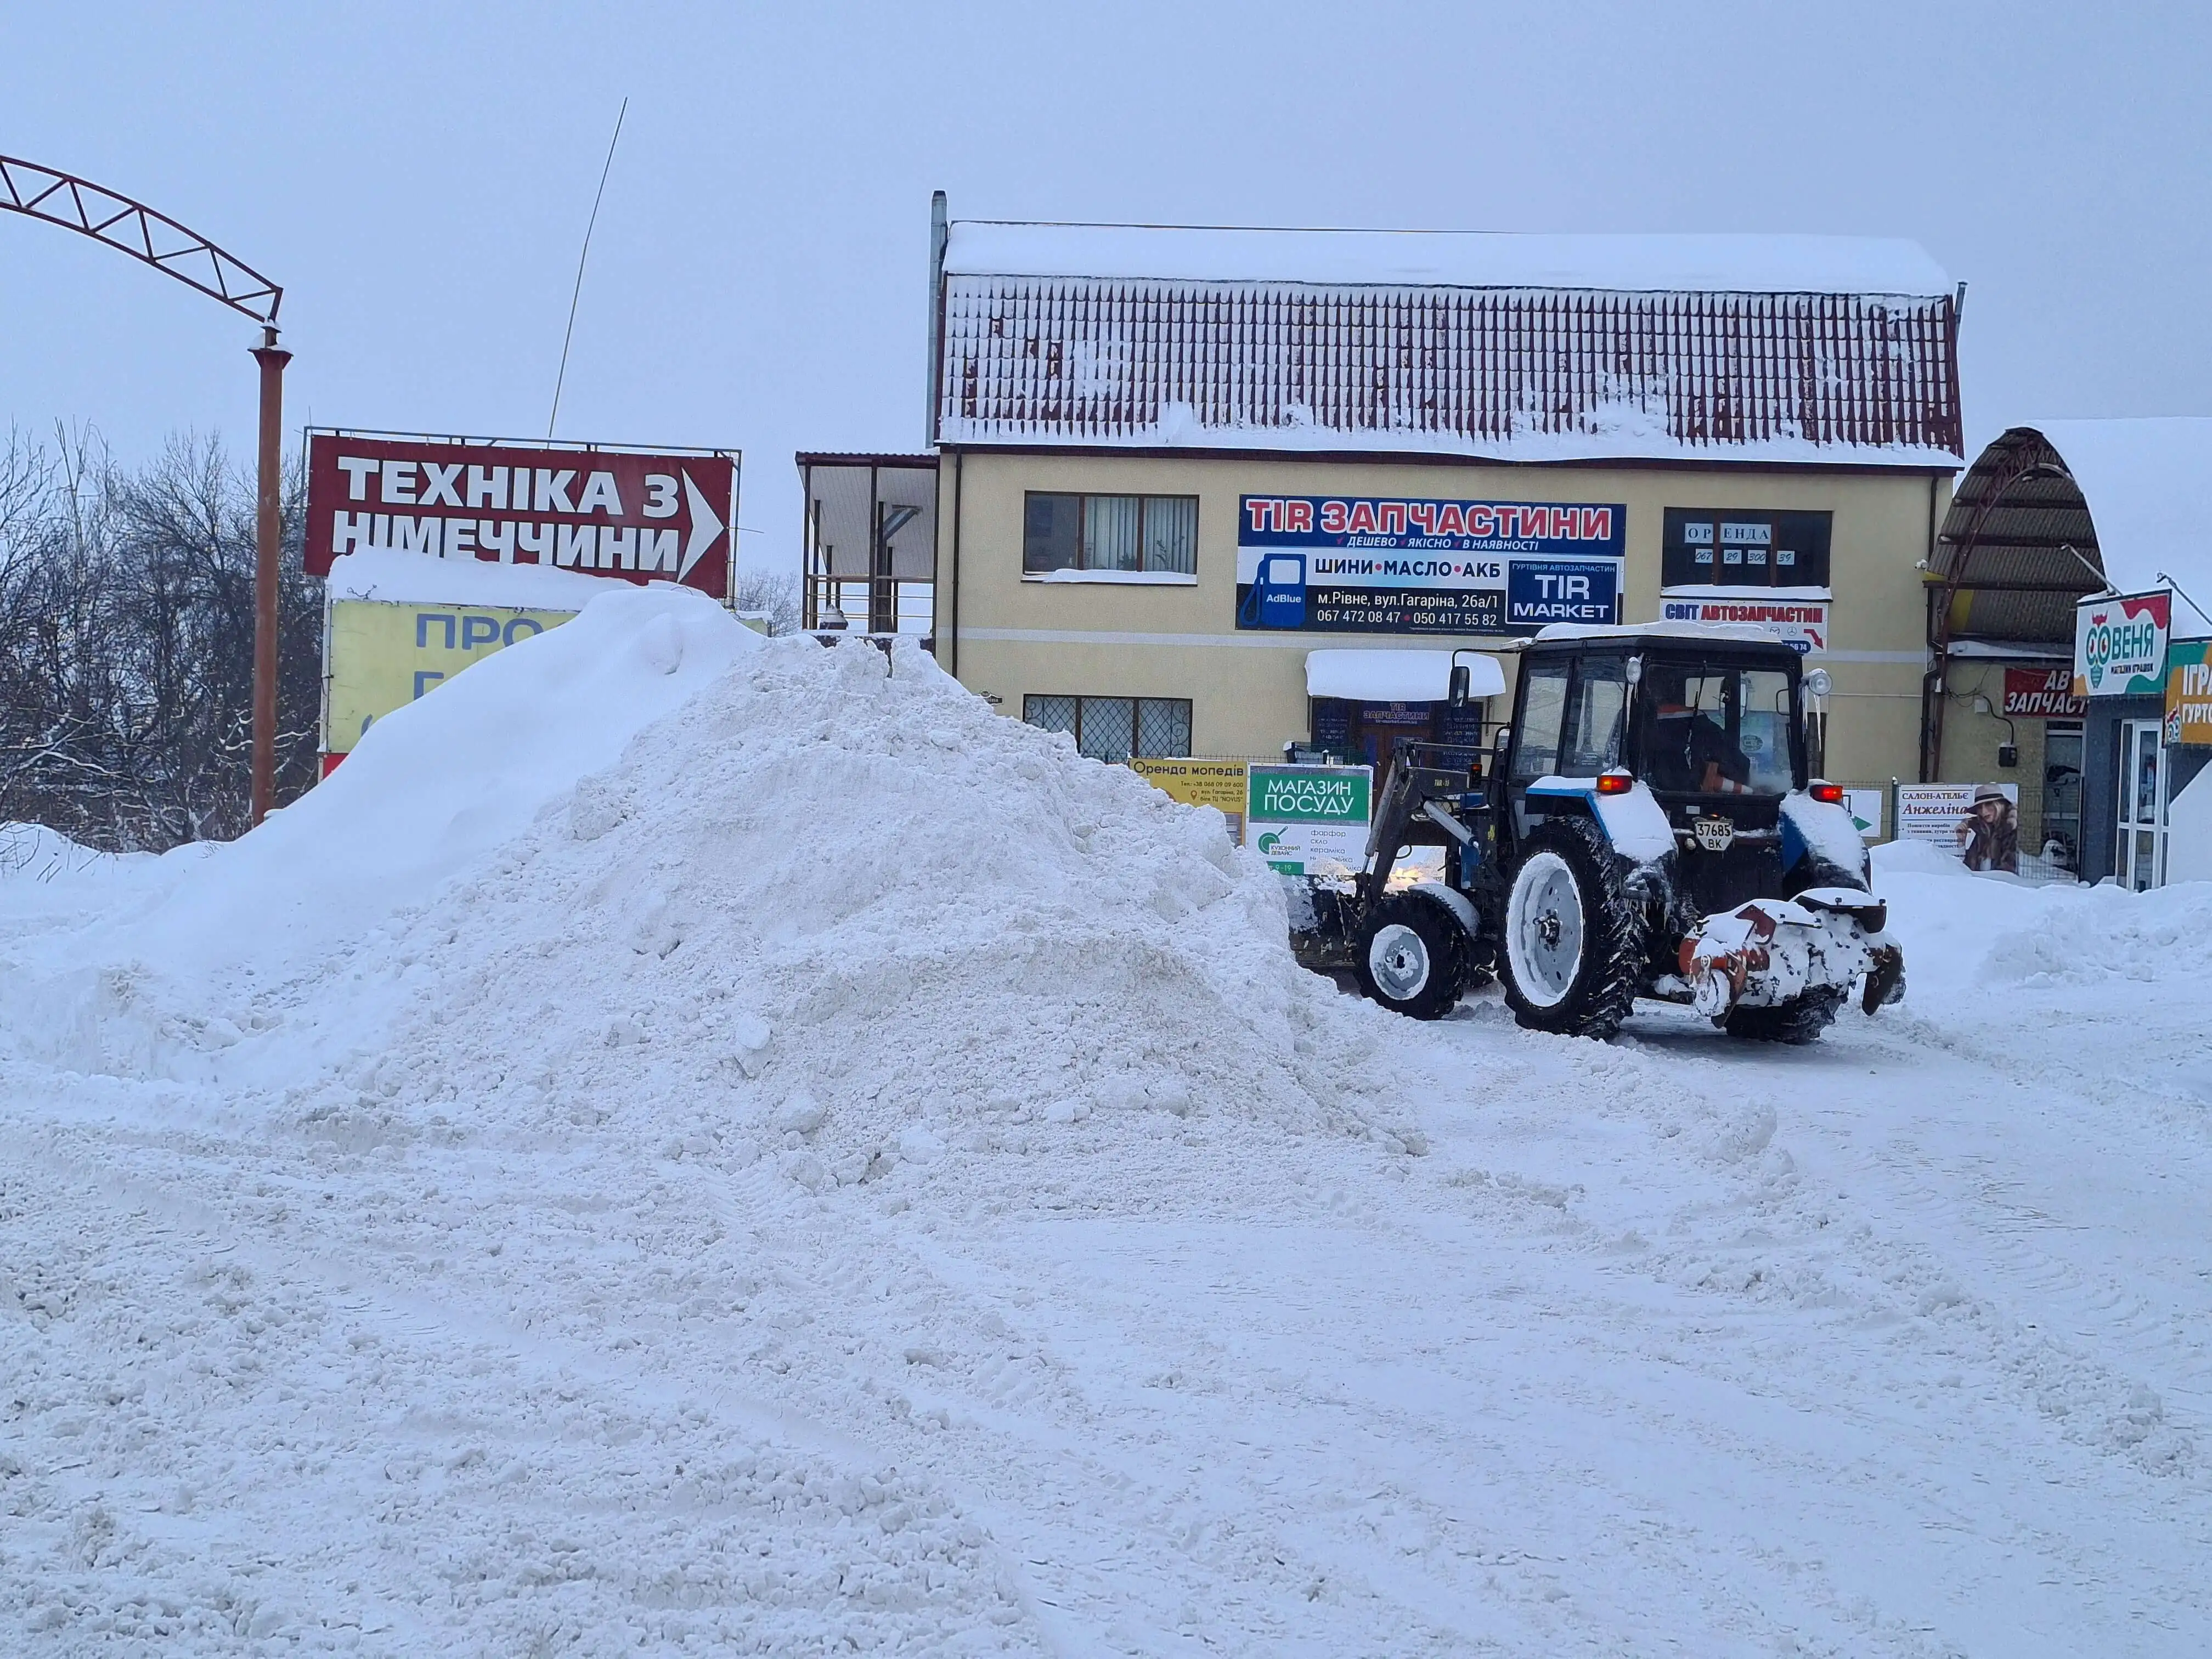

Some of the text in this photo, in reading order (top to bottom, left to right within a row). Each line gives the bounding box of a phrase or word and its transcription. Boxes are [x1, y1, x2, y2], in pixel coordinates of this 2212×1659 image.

[337, 456, 679, 518] ТЕХНІКА З
[1246, 499, 1612, 540] TIR ЗАПЧАСТИНИ
[332, 510, 679, 572] НІМЕЧЧИНИ
[1688, 528, 1769, 540] ОРЕНДА
[1347, 535, 1539, 551] ДЕШЕВО ЯКІСНО В НАЯВНОСТІ
[1695, 552, 1712, 560] 067
[1726, 552, 1738, 561] 29
[1748, 553, 1766, 562] 300
[1315, 558, 1500, 578] ШИНИ МАСЛО АКБ
[1512, 563, 1615, 572] ГУРТІВНЯ АВТОЗАПЧАСТИН
[1534, 574, 1589, 600] TIR
[1266, 594, 1301, 603] AdBlue
[1318, 591, 1497, 609] м.Рівне, вул.Гагаріна, 26а/1
[1317, 610, 1497, 626] 067 472 08 47 050 417 55 82
[1514, 602, 1609, 618] MARKET
[1666, 604, 1822, 623] СВІТ АВТОЗАПЧАСТИН
[416, 613, 568, 650] ПРО
[2086, 623, 2154, 665] СОВЕНЯ
[2044, 670, 2070, 690] АВ
[1363, 710, 1430, 720] ЗАПЧАСТИНИ
[1390, 703, 1406, 711] TIR
[1134, 761, 1244, 776] Оренда мопедів
[1268, 780, 1351, 795] МАГАЗИН
[1265, 794, 1354, 815] ПОСУДУ
[1903, 803, 1968, 815] Анжеліна
[1698, 824, 1730, 837] 37685
